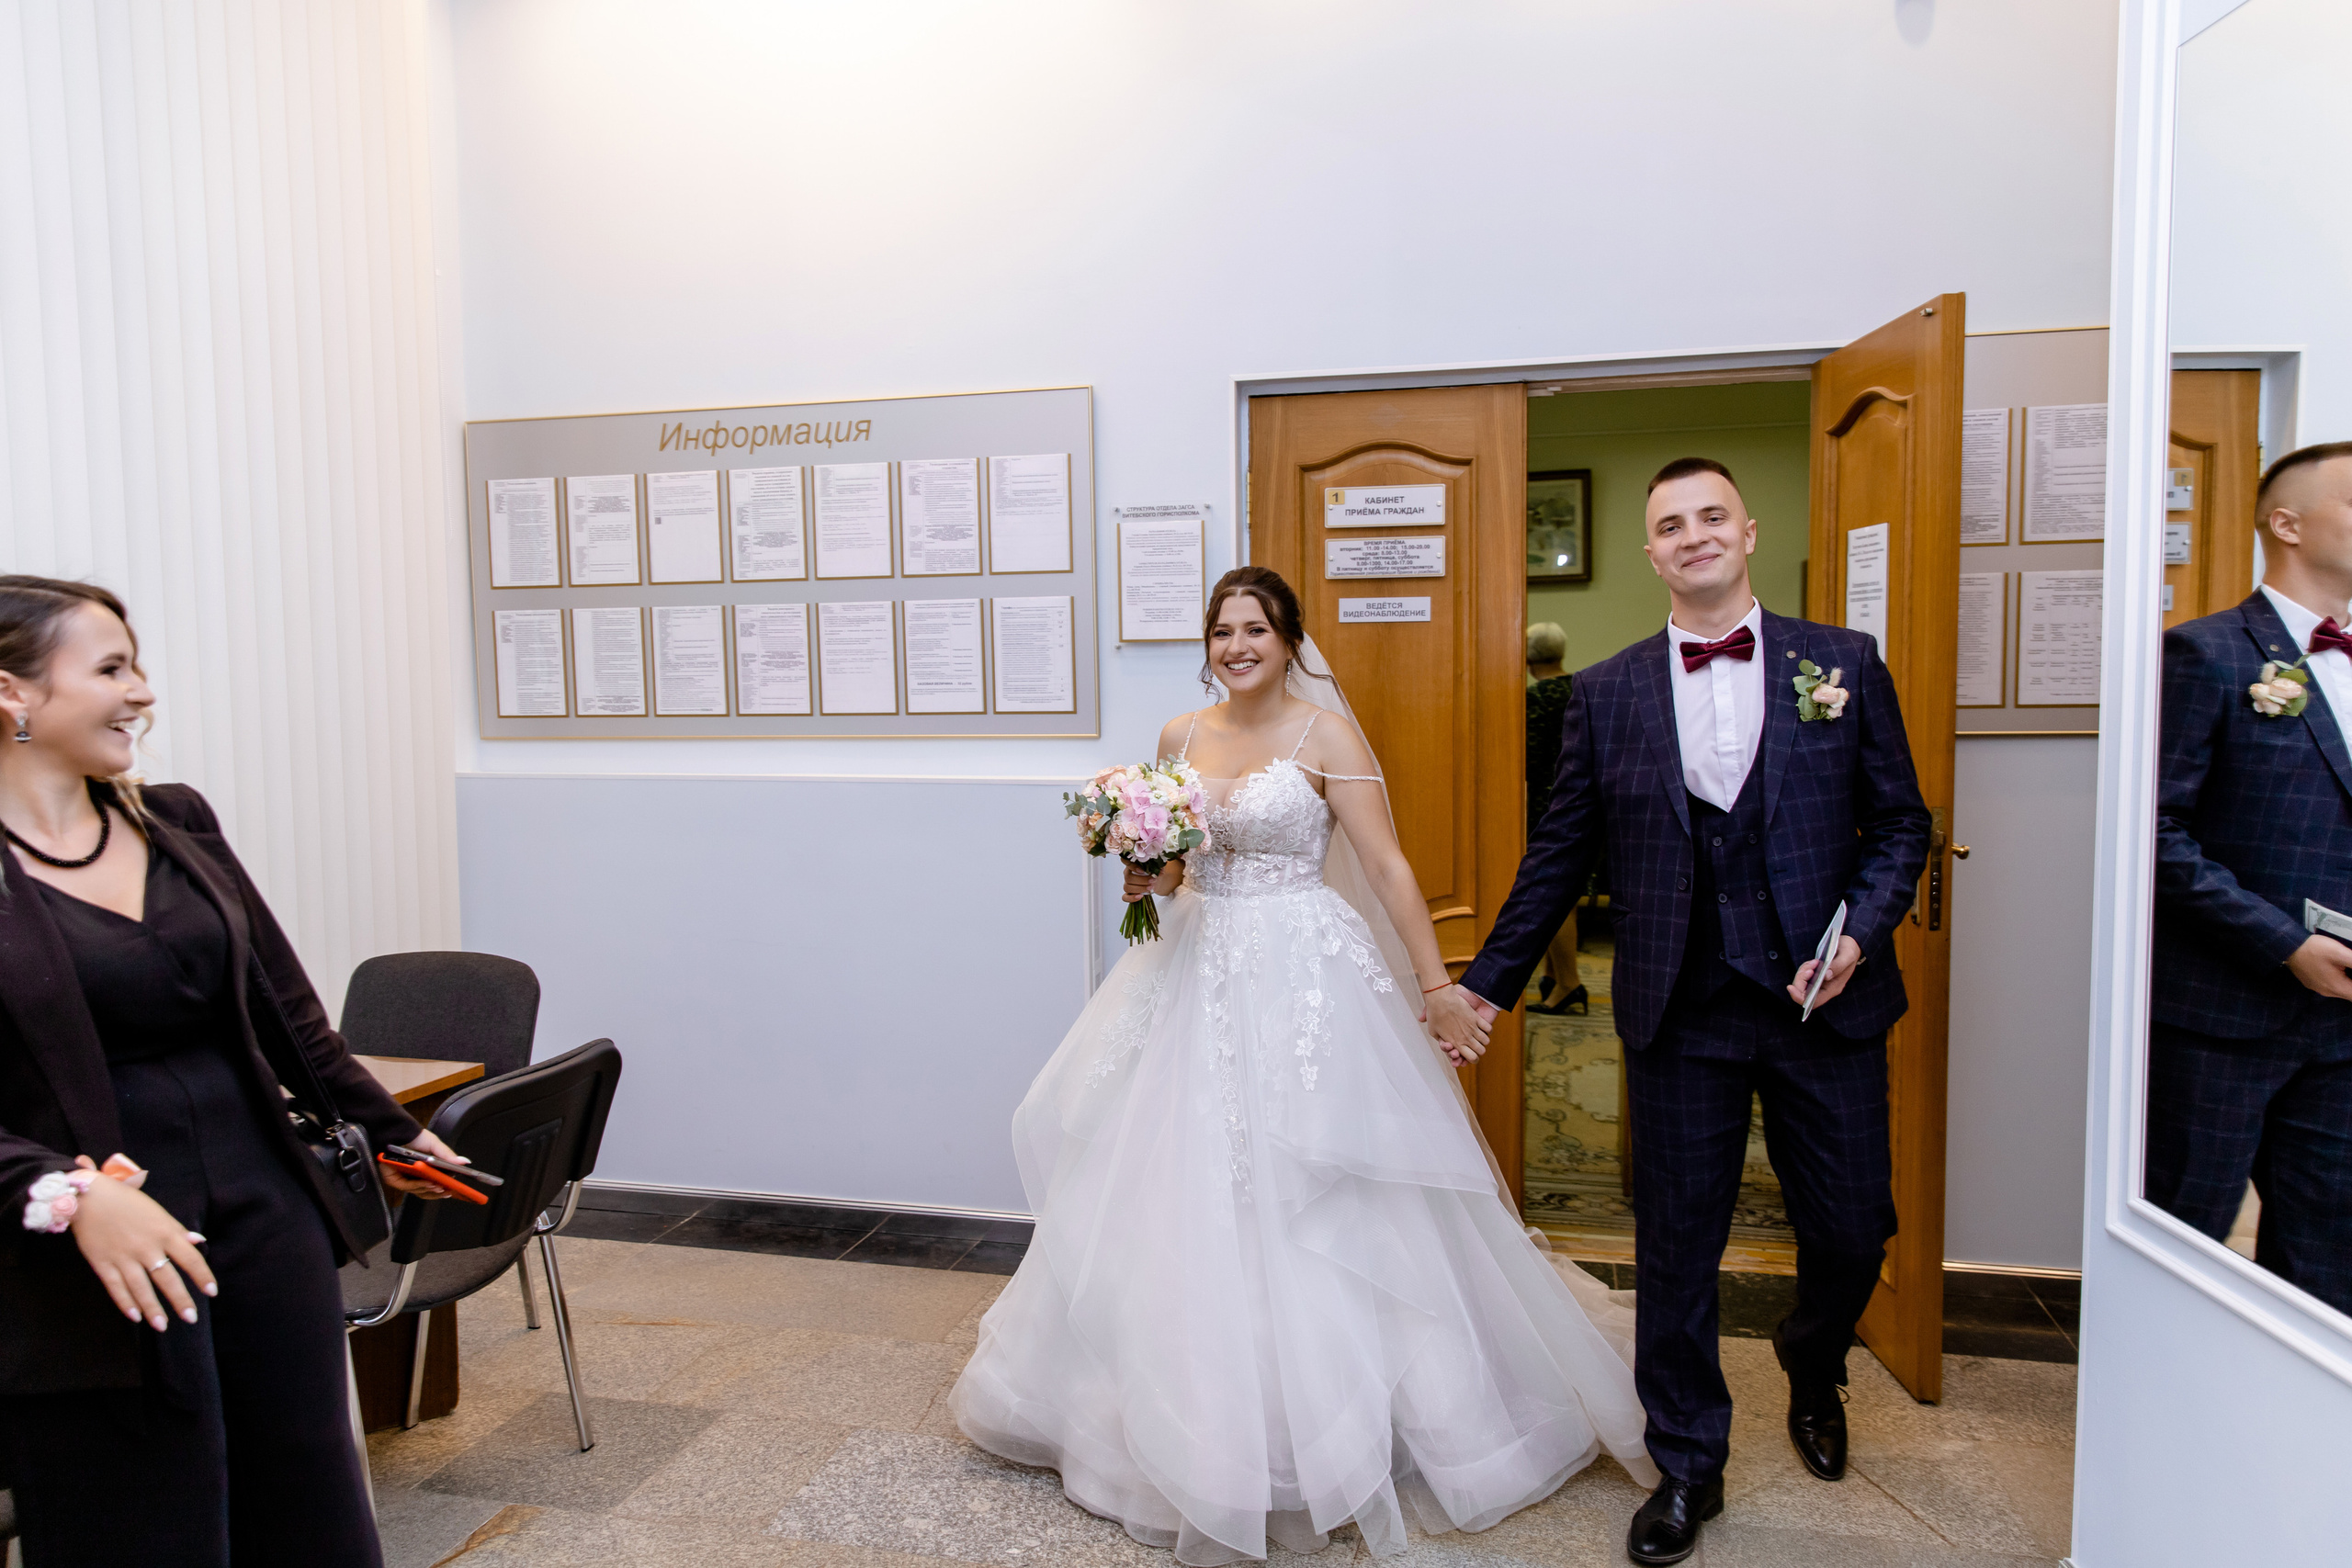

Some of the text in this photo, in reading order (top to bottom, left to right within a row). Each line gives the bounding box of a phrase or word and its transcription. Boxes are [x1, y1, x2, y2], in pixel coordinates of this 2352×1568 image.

[658, 419, 872, 456] Информация
[1332, 493, 1339, 502] 1
[1345, 507, 1381, 516] ПРИЁМА
